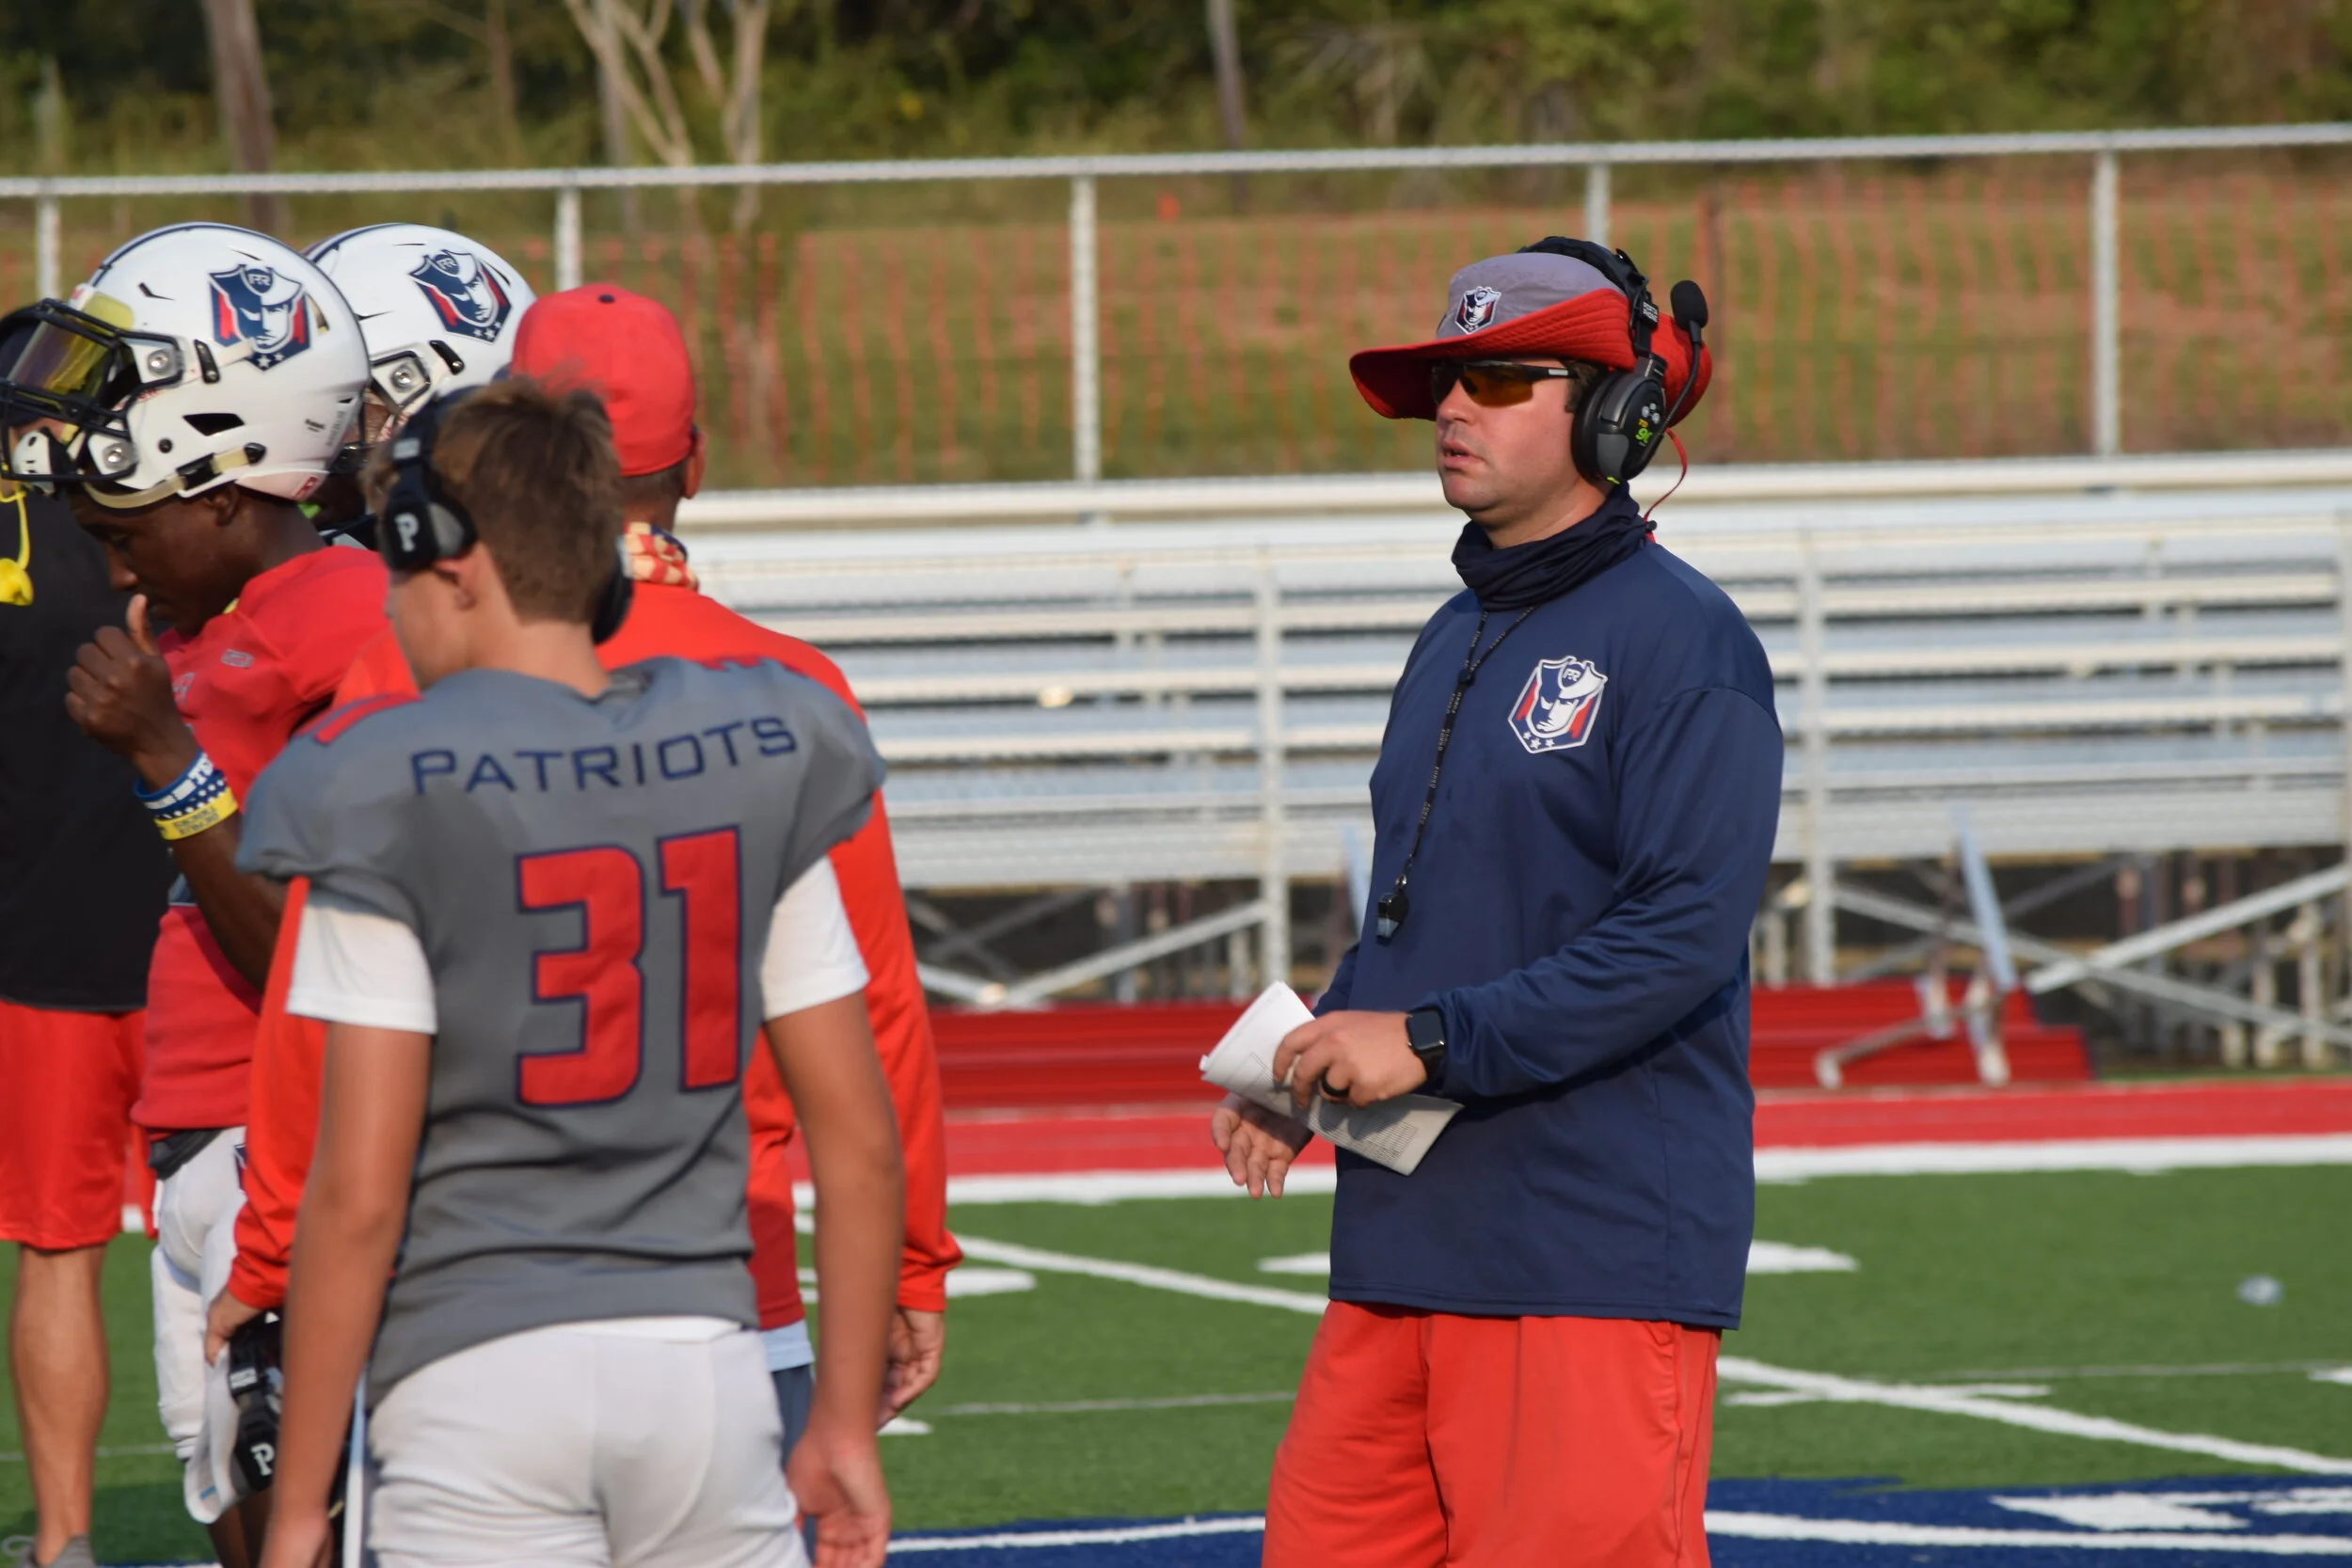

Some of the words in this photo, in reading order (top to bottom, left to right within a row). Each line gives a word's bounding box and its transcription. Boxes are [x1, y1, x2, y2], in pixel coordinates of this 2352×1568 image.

[394, 513, 420, 553] P
[410, 716, 798, 796] PATRIOTS
[515, 824, 741, 1107] 31
[250, 1442, 275, 1477] P
